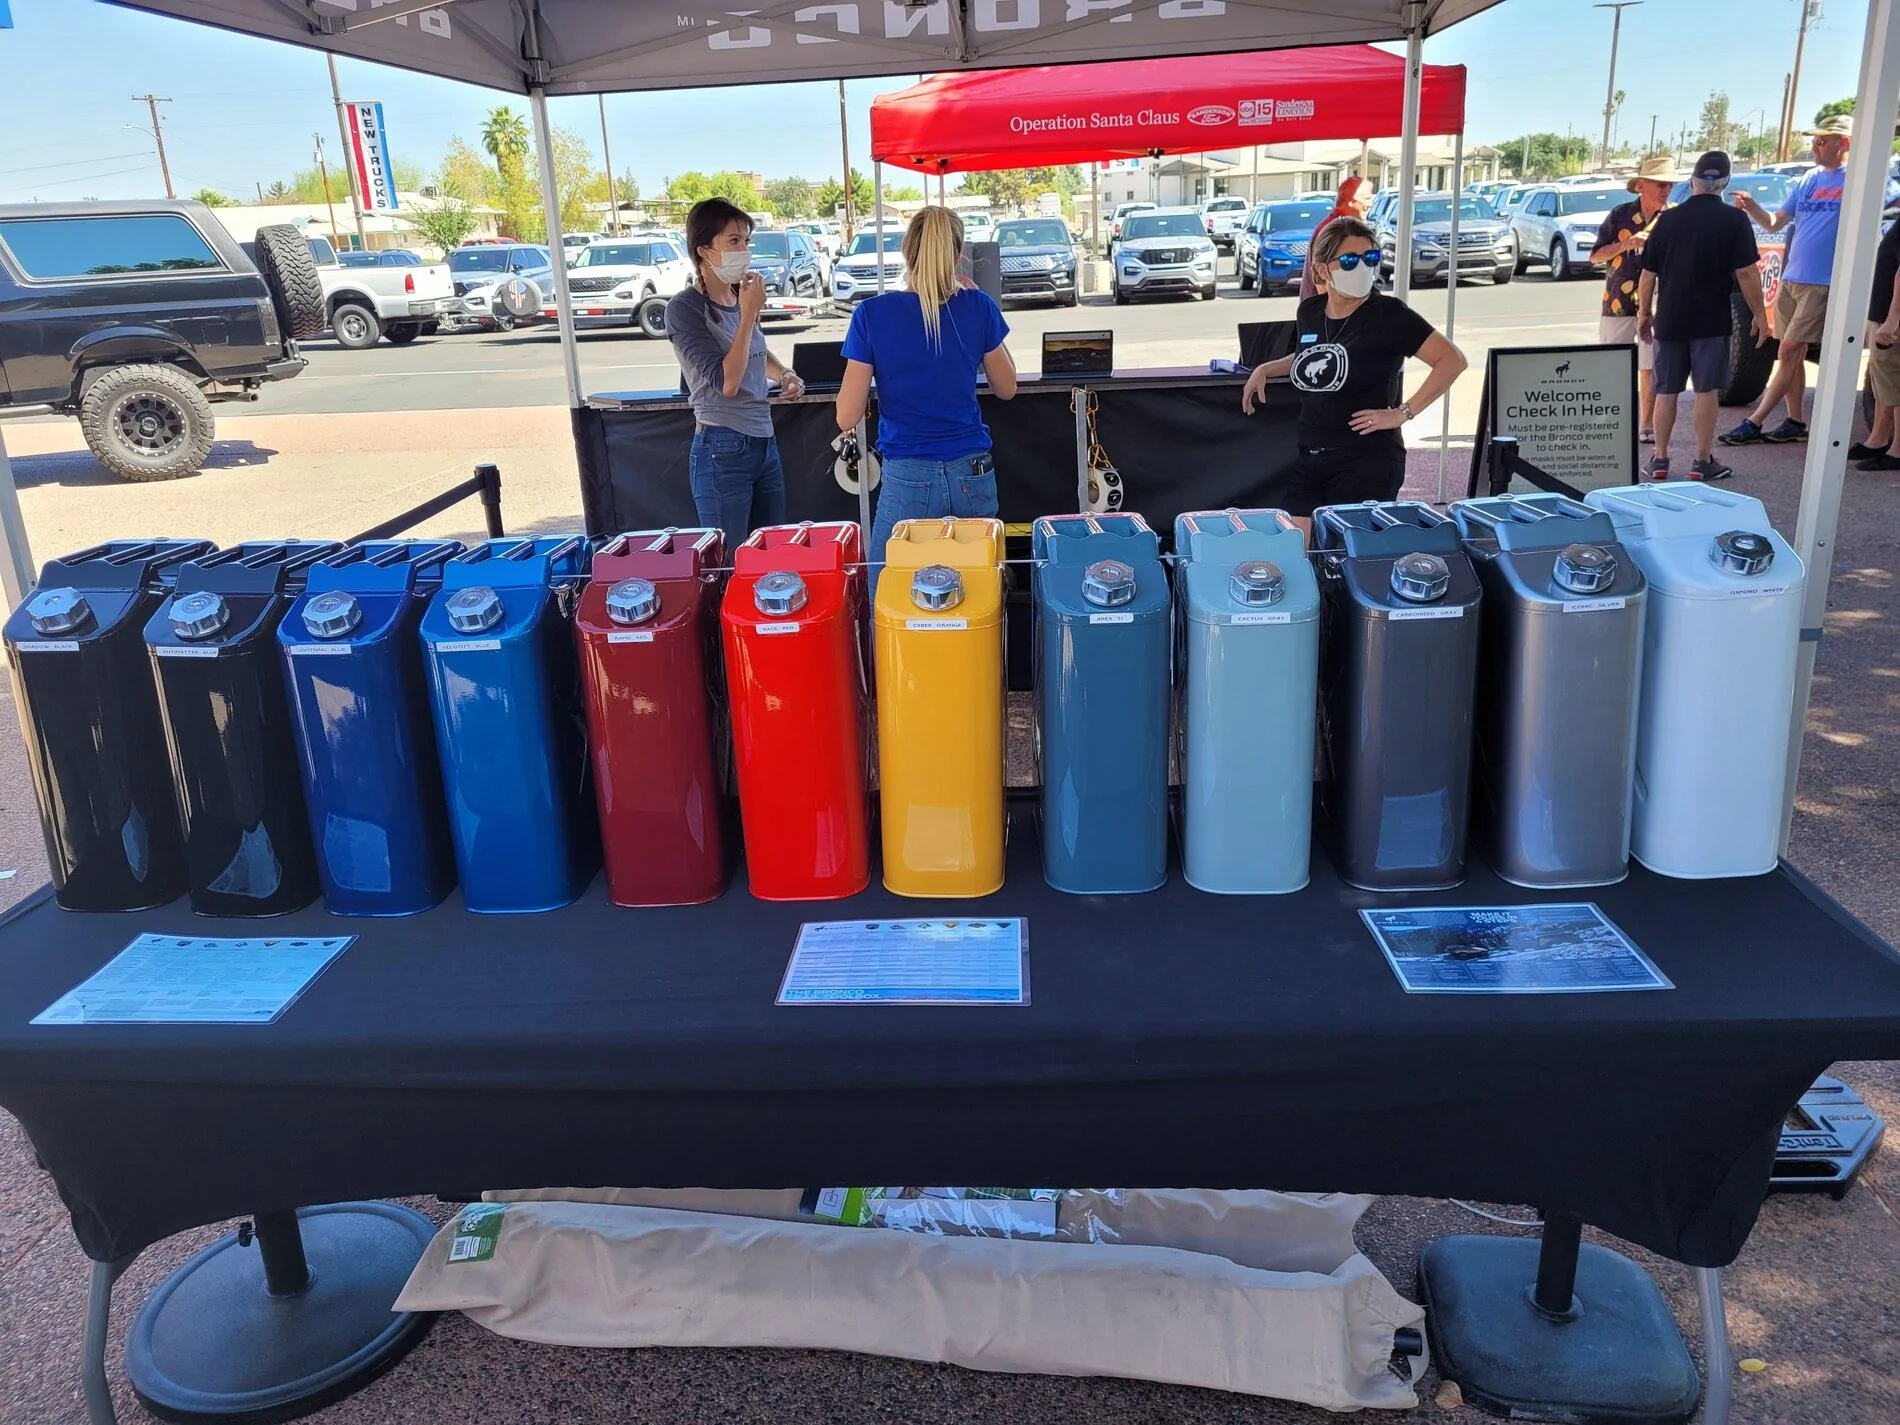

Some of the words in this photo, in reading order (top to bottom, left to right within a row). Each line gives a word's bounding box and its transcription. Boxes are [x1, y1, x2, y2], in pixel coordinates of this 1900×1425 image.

[1240, 105, 1254, 113] abc
[1257, 102, 1272, 115] 15
[1276, 98, 1314, 108] Sanderson
[1191, 106, 1231, 118] SANDERSON
[1201, 113, 1221, 123] Ford
[1276, 108, 1313, 116] LINCOLN
[1010, 115, 1086, 135] Operation
[1090, 111, 1133, 128] Santa
[1137, 109, 1180, 126] Claus
[361, 107, 376, 139] NEW
[369, 145, 387, 208] TRUCKS
[1761, 268, 1773, 289] 16
[1524, 390, 1602, 403] Welcome
[1506, 405, 1557, 418] Check
[1562, 405, 1577, 417] In
[1581, 403, 1621, 416] Here
[1508, 424, 1533, 432] Must
[1535, 423, 1547, 432] be
[1549, 421, 1619, 433] pre-registered
[1514, 434, 1527, 442] for
[1530, 433, 1546, 441] the
[1548, 432, 1583, 441] Bronco
[1585, 432, 1613, 440] event
[1536, 443, 1546, 451] to
[1548, 442, 1577, 451] check
[1556, 454, 1574, 462] must
[1576, 453, 1586, 461] be
[1580, 461, 1619, 469] distancing
